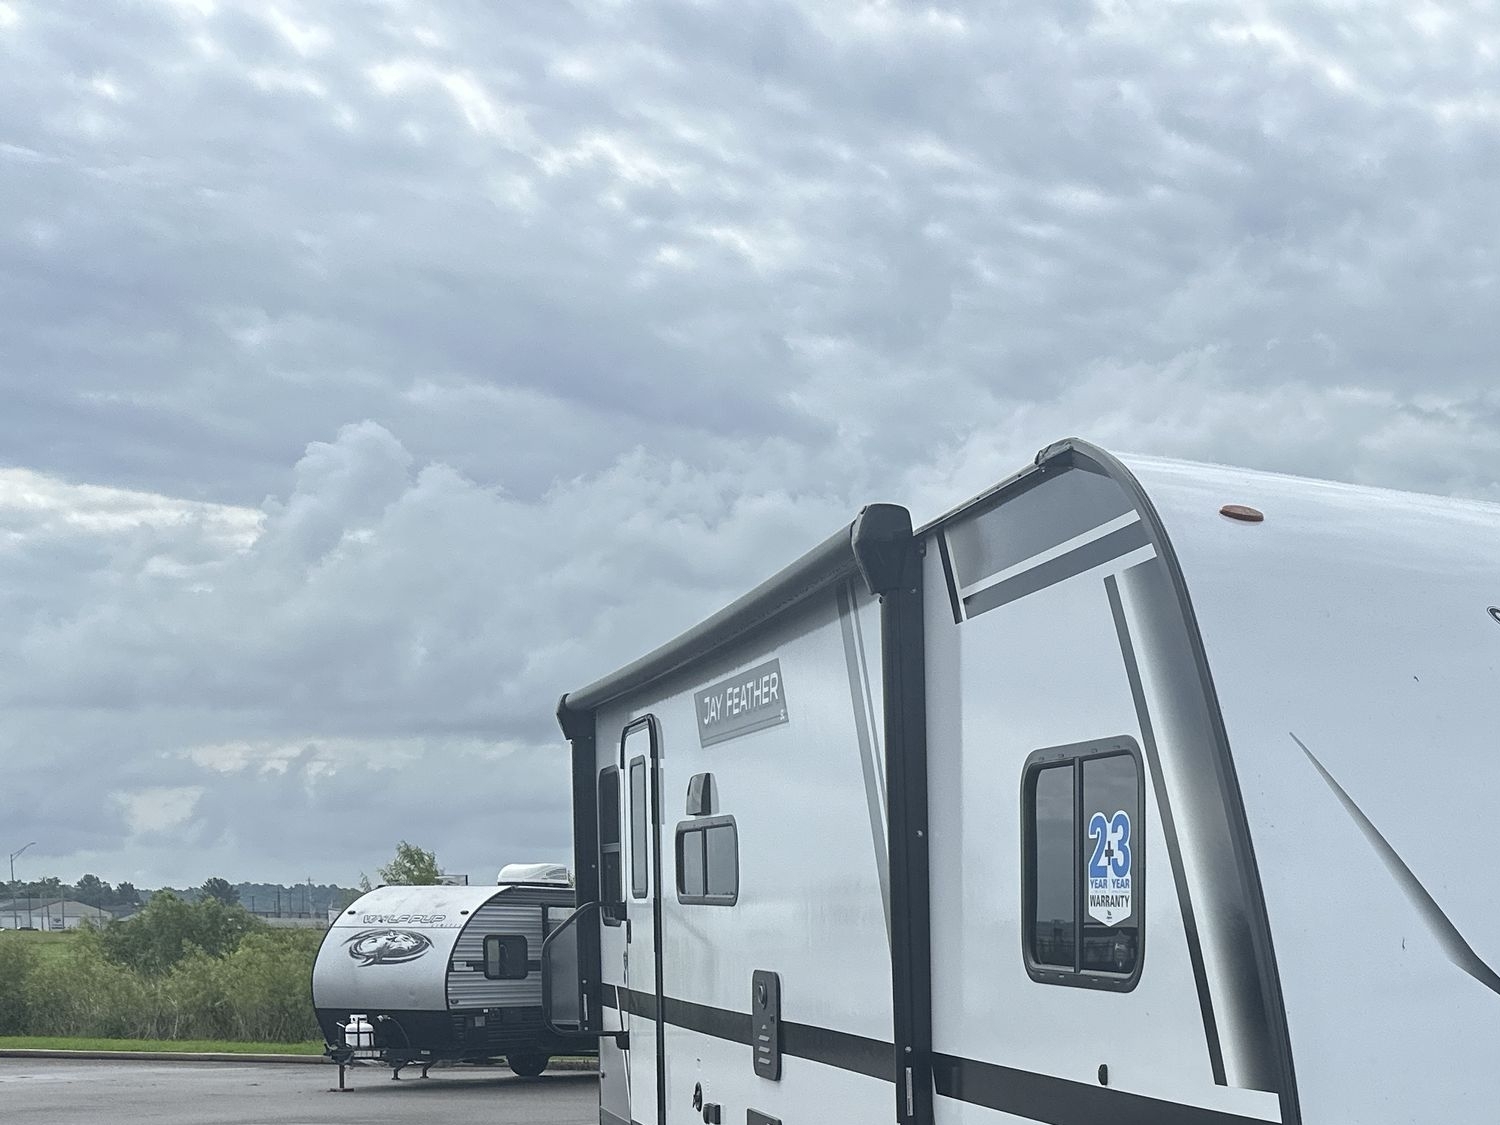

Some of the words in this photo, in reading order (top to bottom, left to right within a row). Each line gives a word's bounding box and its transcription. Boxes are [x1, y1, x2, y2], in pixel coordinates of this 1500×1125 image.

[703, 693, 724, 725] JAY
[726, 671, 779, 718] FEATHER
[1090, 879, 1108, 889] YEAR
[1111, 879, 1130, 889] YEAR
[1090, 895, 1130, 908] WARRANTY
